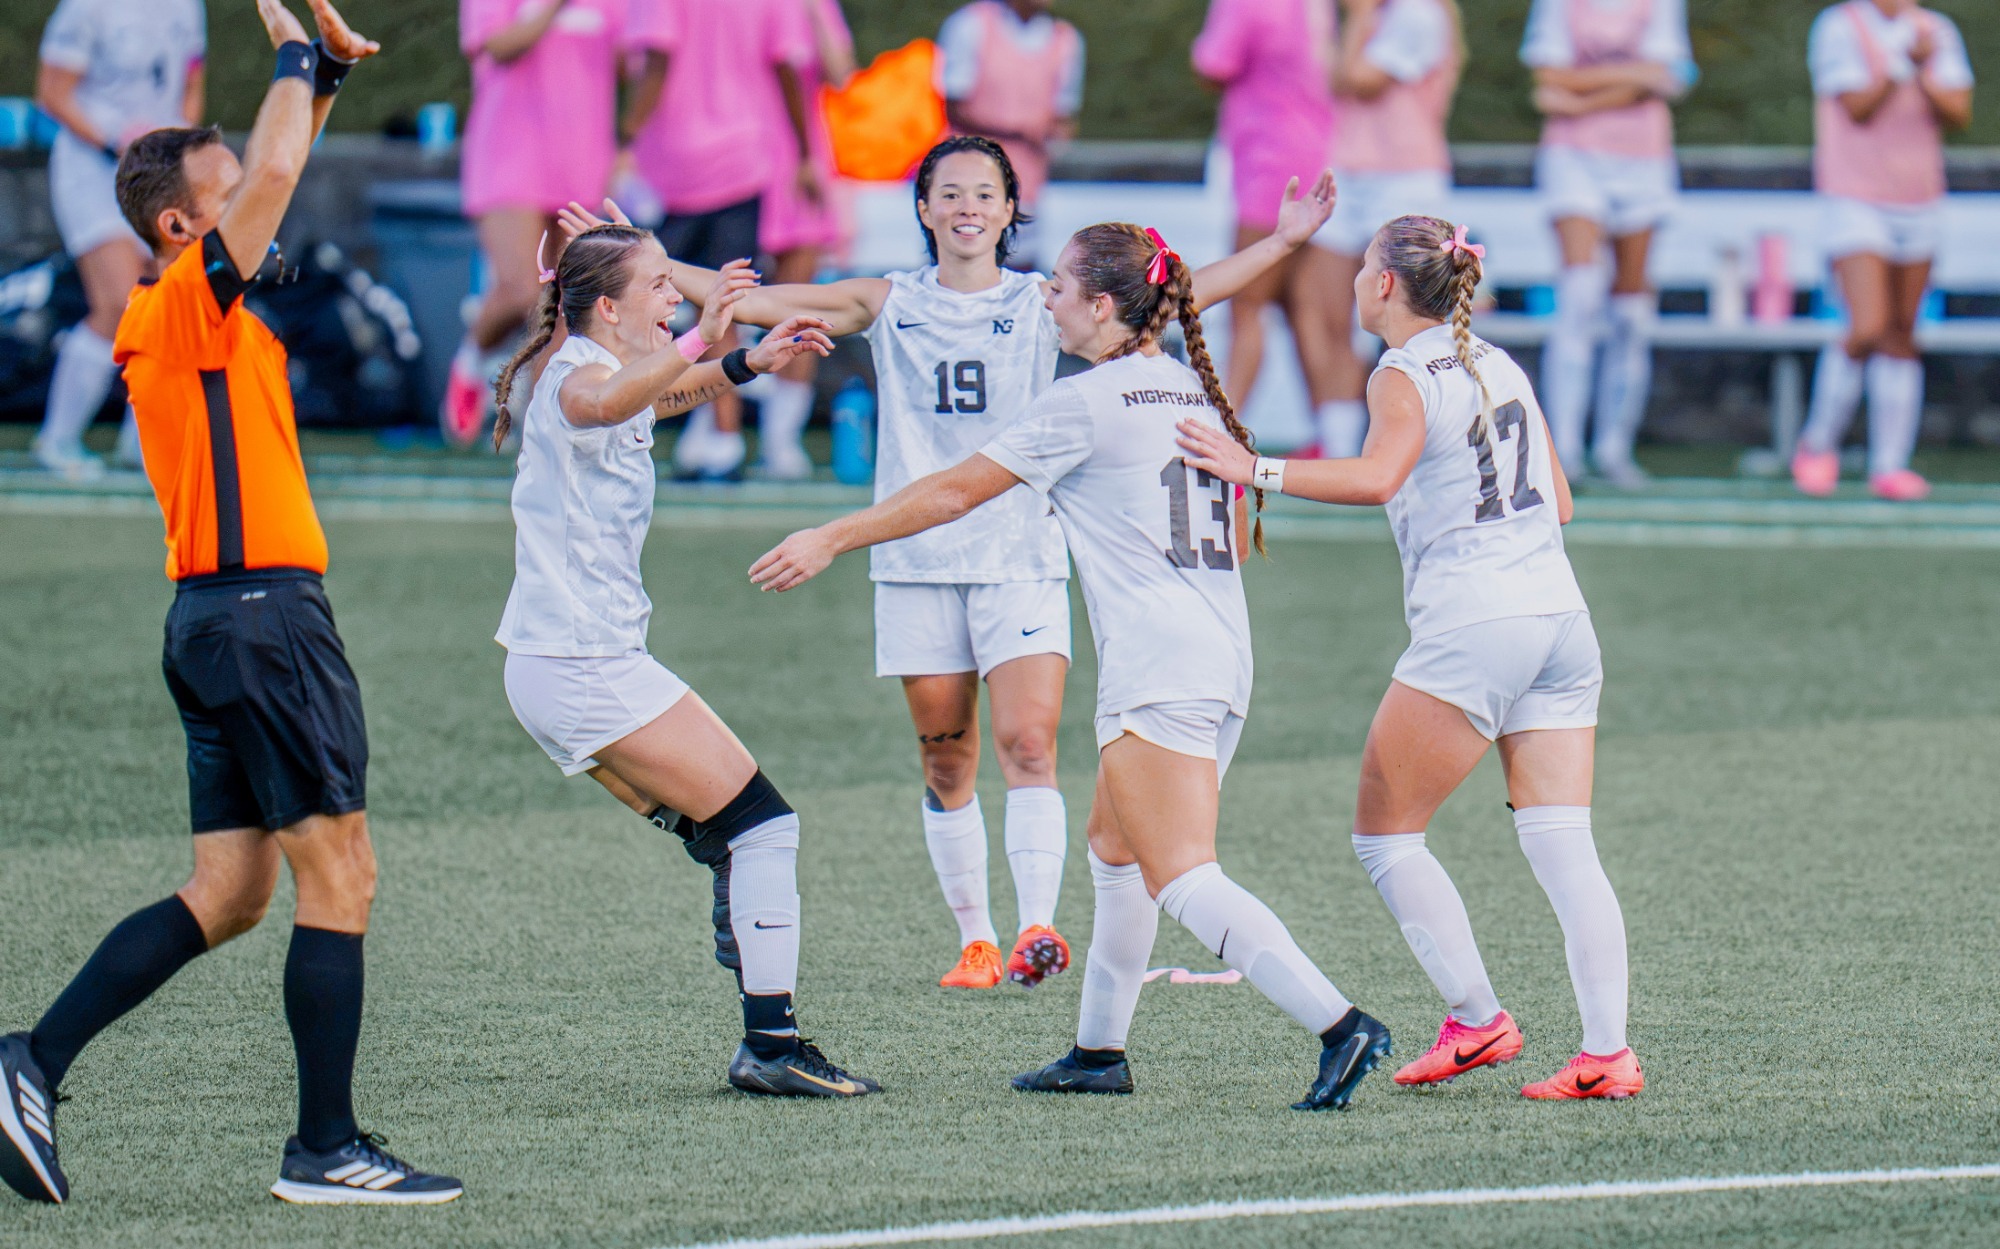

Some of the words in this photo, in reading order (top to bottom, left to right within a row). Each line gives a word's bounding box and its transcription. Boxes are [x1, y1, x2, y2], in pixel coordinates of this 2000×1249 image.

[992, 319, 1014, 334] NG
[934, 360, 987, 413] 19
[1467, 398, 1545, 524] 17
[1160, 456, 1234, 571] 13
